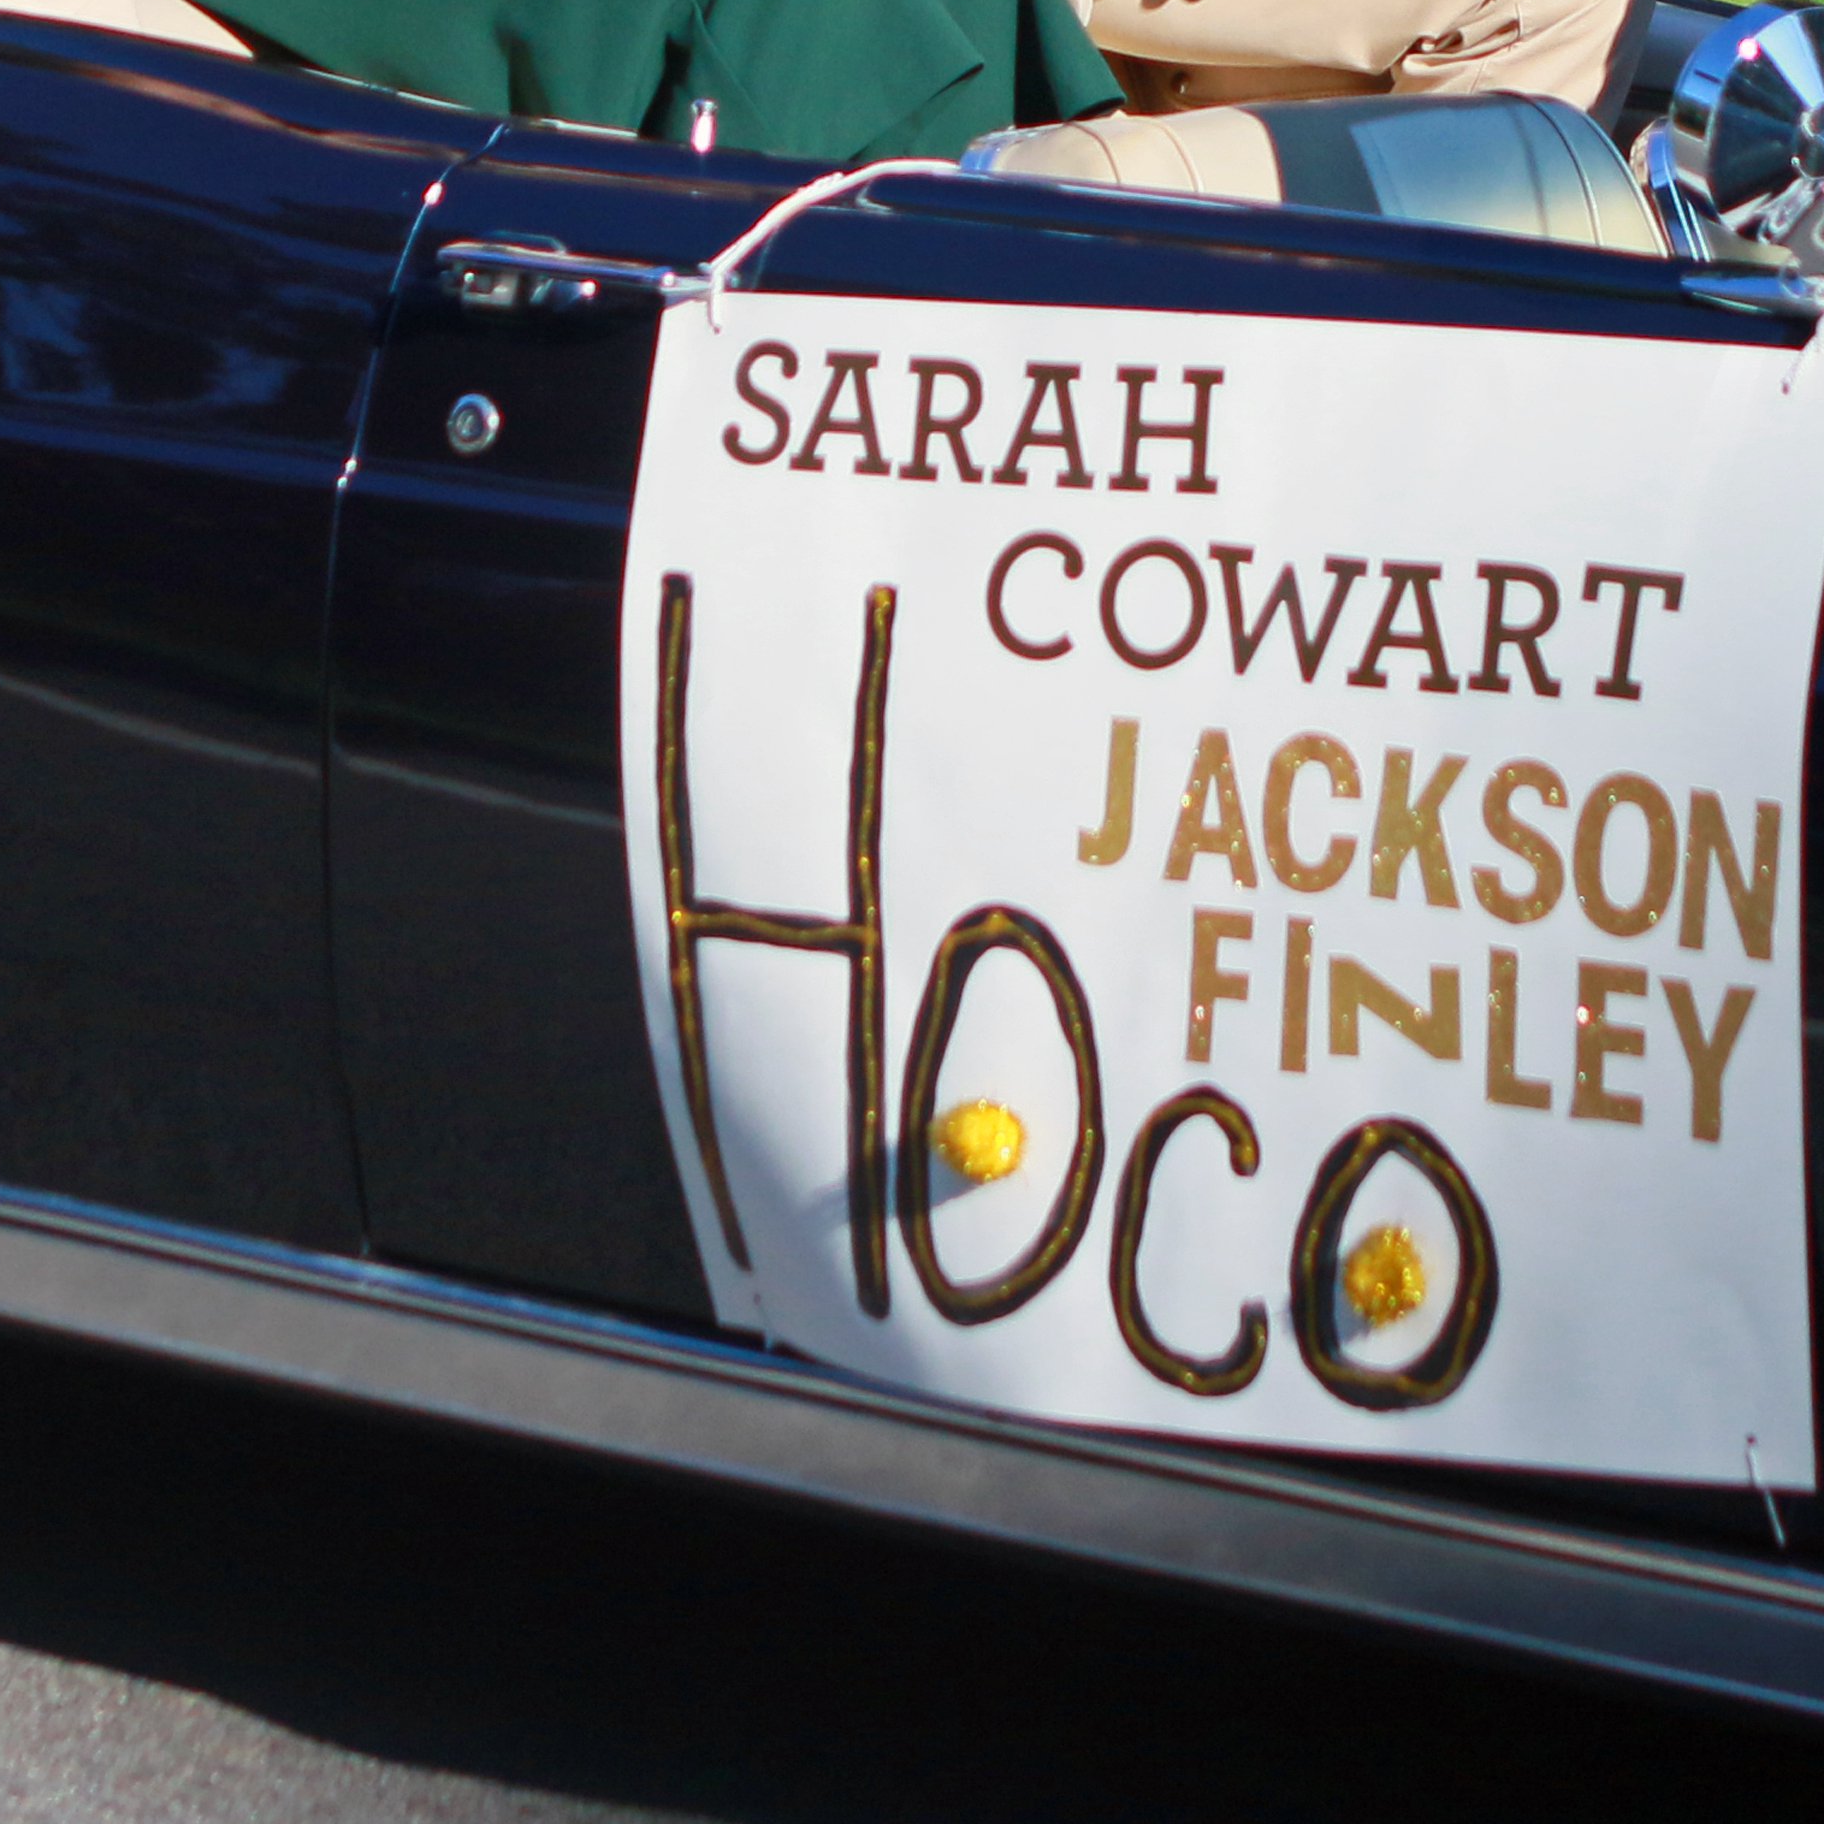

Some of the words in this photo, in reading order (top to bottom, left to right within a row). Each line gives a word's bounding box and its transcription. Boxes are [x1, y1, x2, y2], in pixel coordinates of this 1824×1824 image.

[722, 340, 1225, 495] SARAH
[986, 531, 1685, 702] COWART
[1077, 718, 1782, 964] JACKSON
[1185, 906, 1757, 1144] FINLEY
